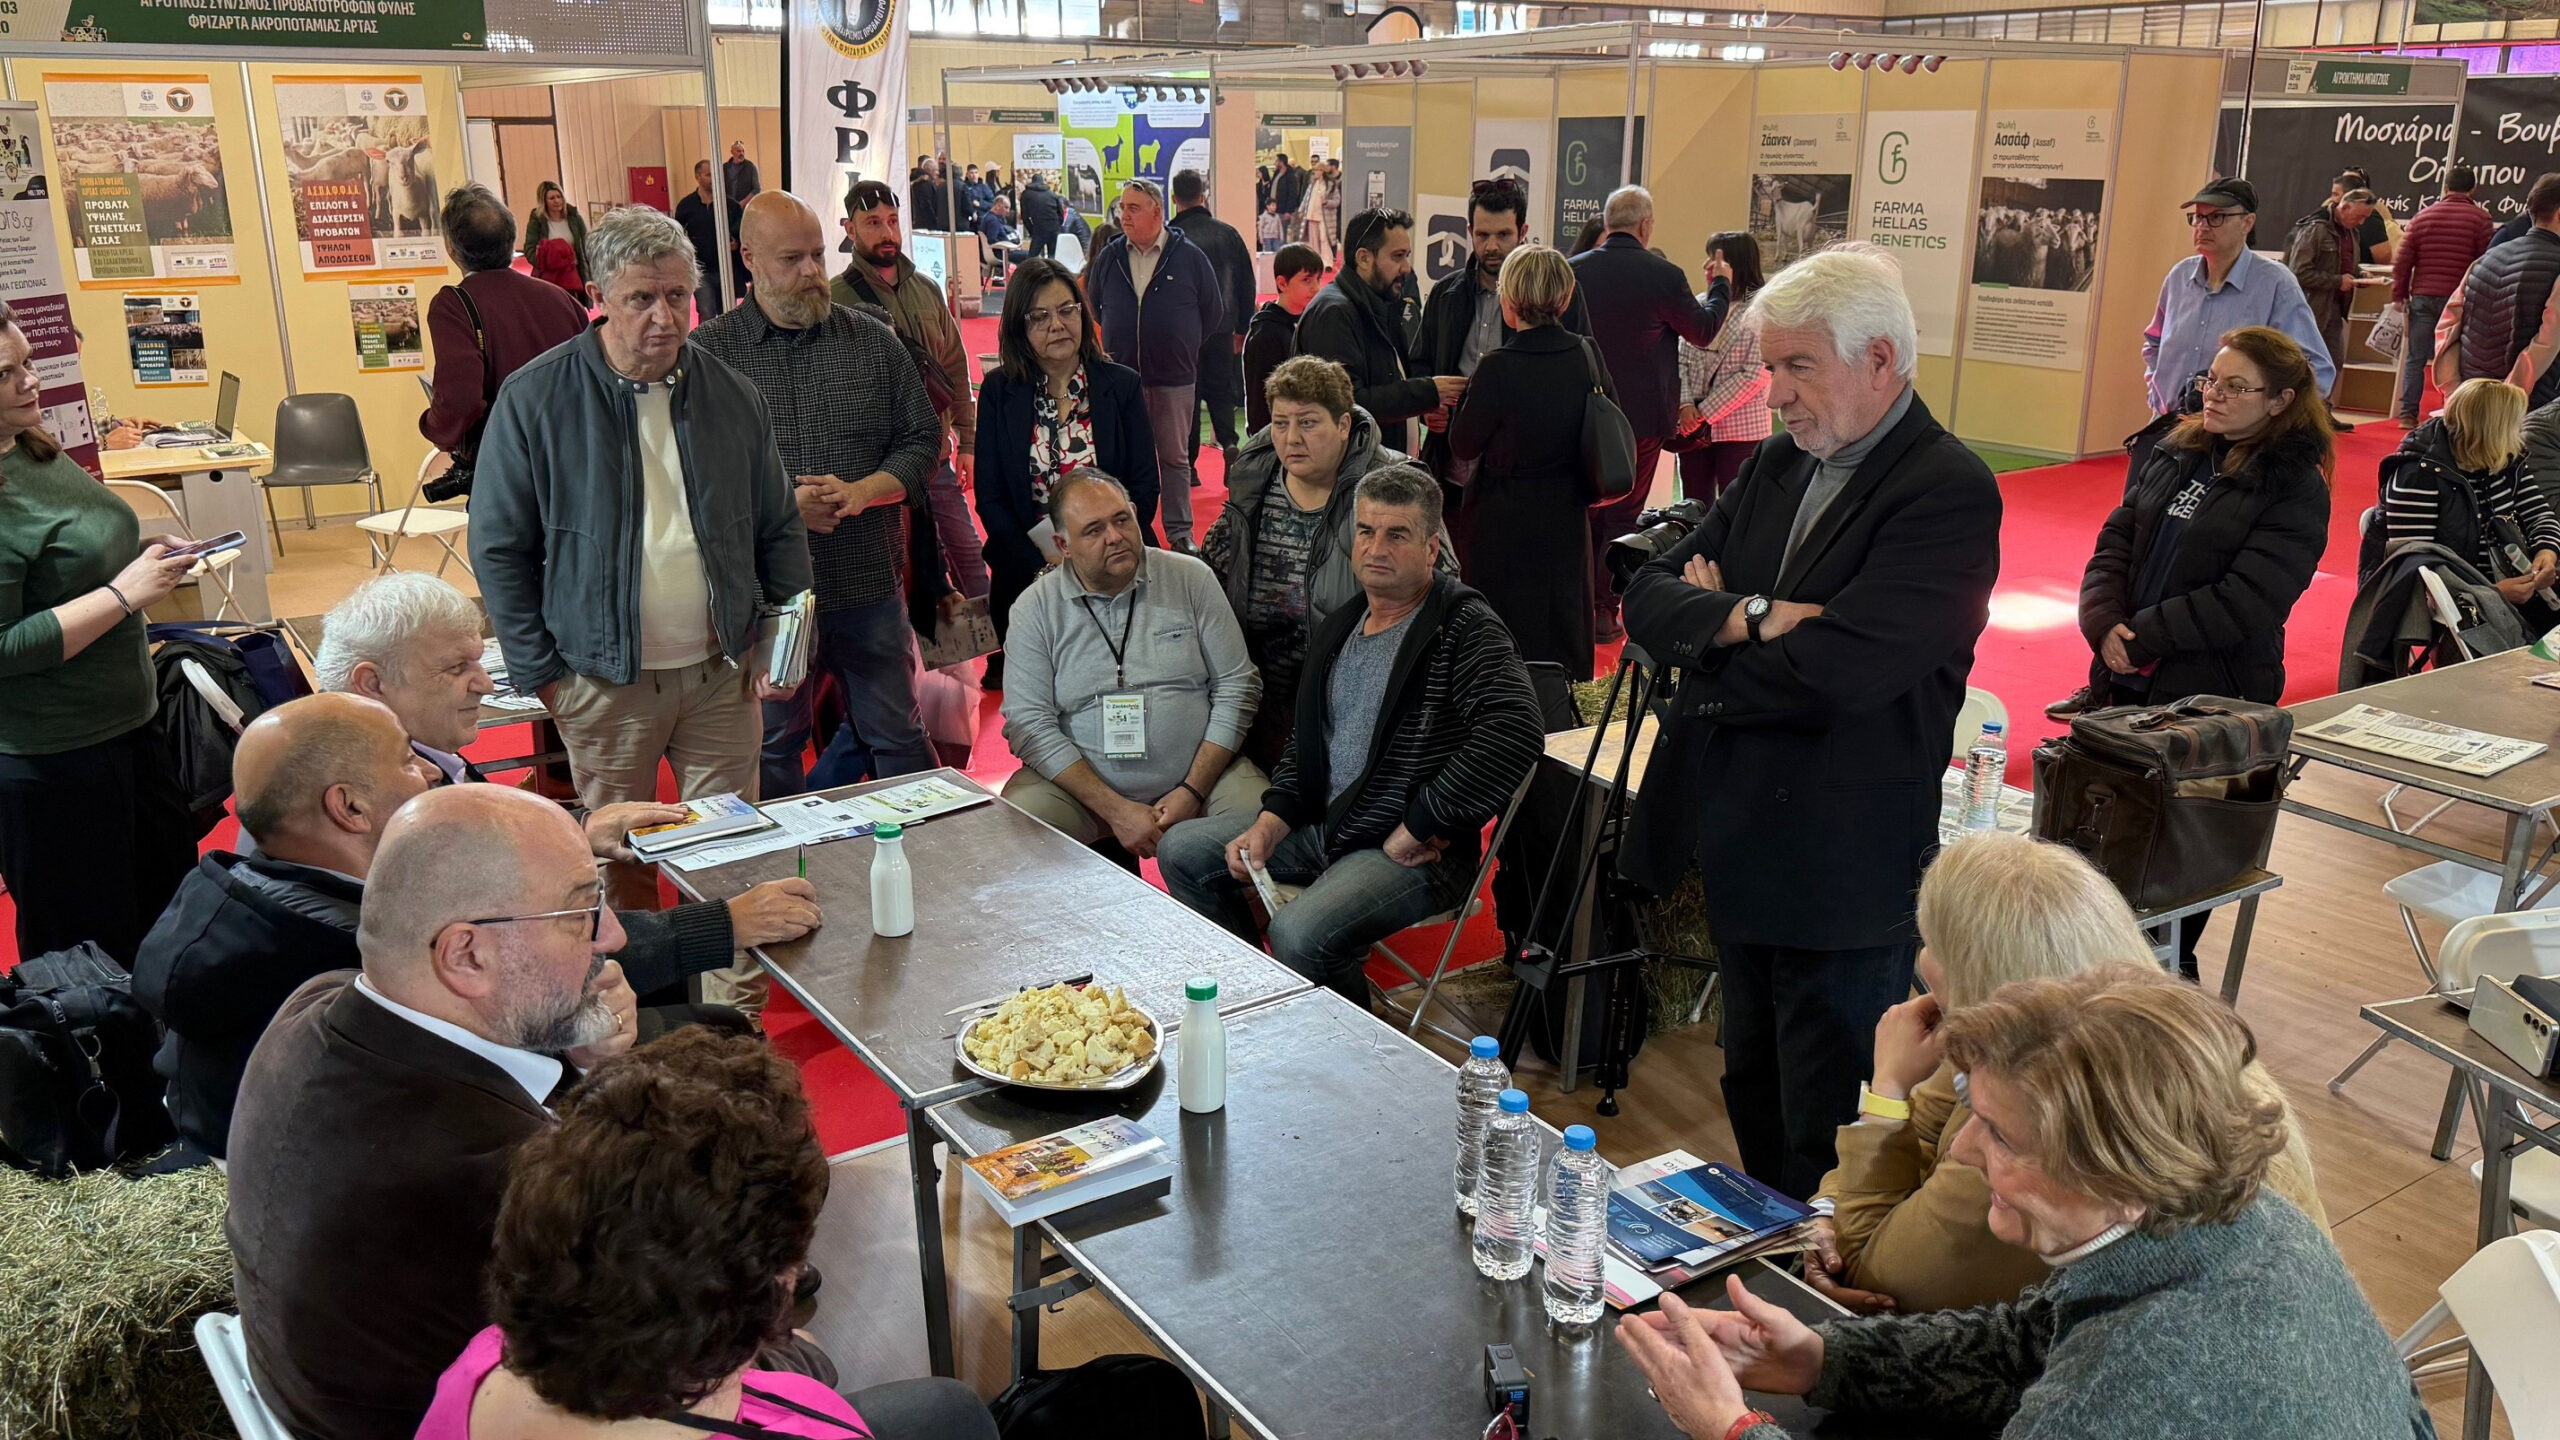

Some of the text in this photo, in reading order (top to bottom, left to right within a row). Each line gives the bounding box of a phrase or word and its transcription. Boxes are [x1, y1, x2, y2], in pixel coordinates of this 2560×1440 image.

[0, 1, 18, 14] 03
[273, 0, 375, 14] ΠΡΟΒΑΤΟΤΡΟΦΩΝ
[377, 1, 416, 16] ΦΥΛΗΣ
[188, 13, 379, 34] ΦΡΙΖΑΡΤΑ ΑΚΡΟΠΟΤΑΜΙΑΣ ΑΡΤΑΣ
[1760, 133, 1792, 147] Ζάανεν
[1994, 131, 2030, 149] Ασσάφ
[2408, 155, 2526, 186] Οπου
[84, 200, 129, 210] ΠΡΟΒΑΤΑ
[310, 201, 359, 211] ΕΠΙΛΟΓΗ &
[1563, 199, 1600, 211] FARMA
[1873, 201, 1924, 215] FARMA
[86, 212, 125, 222] ΥΨΗΛΗΣ
[312, 213, 365, 224] ΔΙΑΧΕΙΡΙΣΗ
[88, 223, 143, 234] ΓΕΝΕΤΙΚΗΣ
[1872, 217, 1928, 231] HELLAS
[313, 226, 361, 237] ΠΡΟΒΑΤΩΝ
[90, 235, 121, 246] ΑΞΙΑΣ
[1870, 233, 1947, 249] GENETICS
[316, 243, 352, 252] ΥΨΗΛΩΝ
[318, 253, 373, 264] ΑΠΟΔΟΣΕΩΝ
[10, 278, 48, 290] ΓΕΩΠΟΝΙΑΣ
[1510, 1391, 1524, 1400] 12
